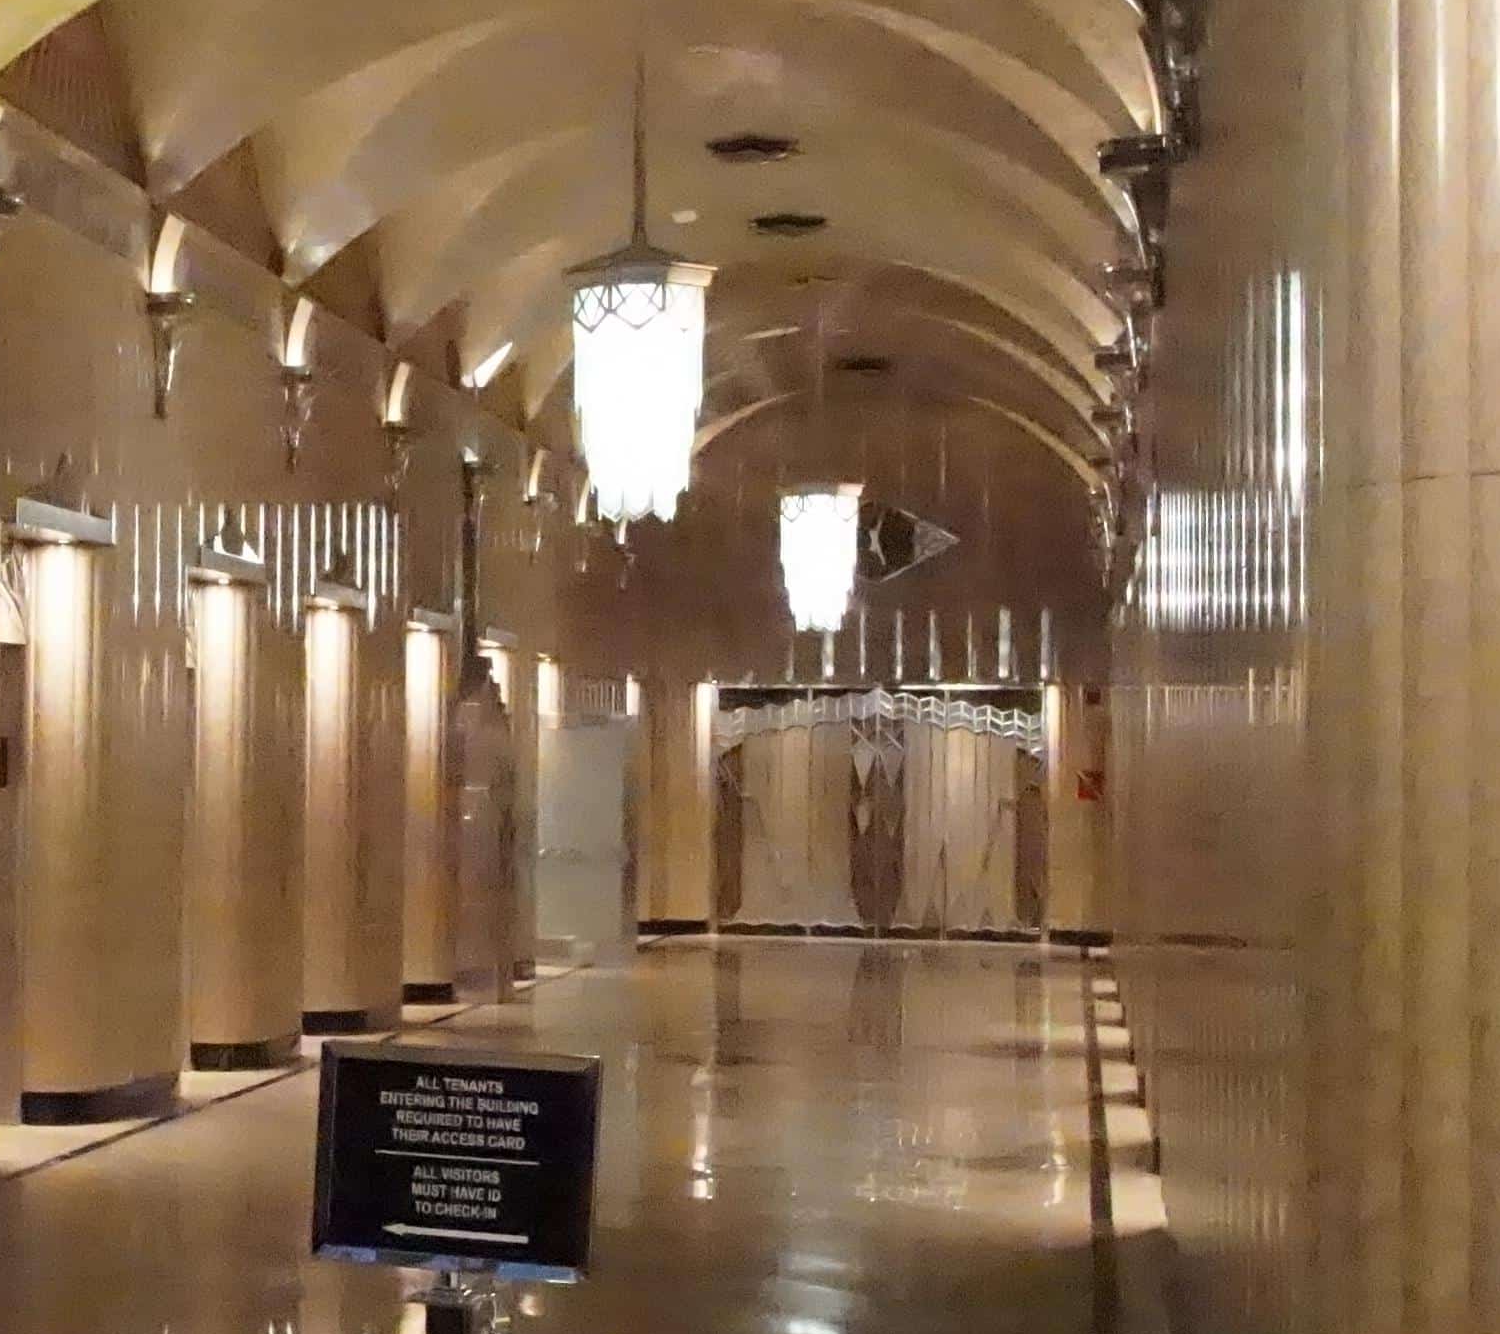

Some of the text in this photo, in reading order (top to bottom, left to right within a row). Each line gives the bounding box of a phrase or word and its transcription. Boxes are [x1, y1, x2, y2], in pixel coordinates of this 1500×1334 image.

[416, 1076, 503, 1094] ALL TENANTS
[380, 1091, 538, 1115] ENTERING THE BUILDING
[396, 1110, 522, 1131] REQUIRED TO HAVE
[392, 1128, 525, 1149] THEIR ACCESS CARD
[413, 1166, 500, 1184] ALL VISITORS
[412, 1183, 501, 1202] MUST HAVE ID
[415, 1201, 497, 1219] TO CHECK-IN
